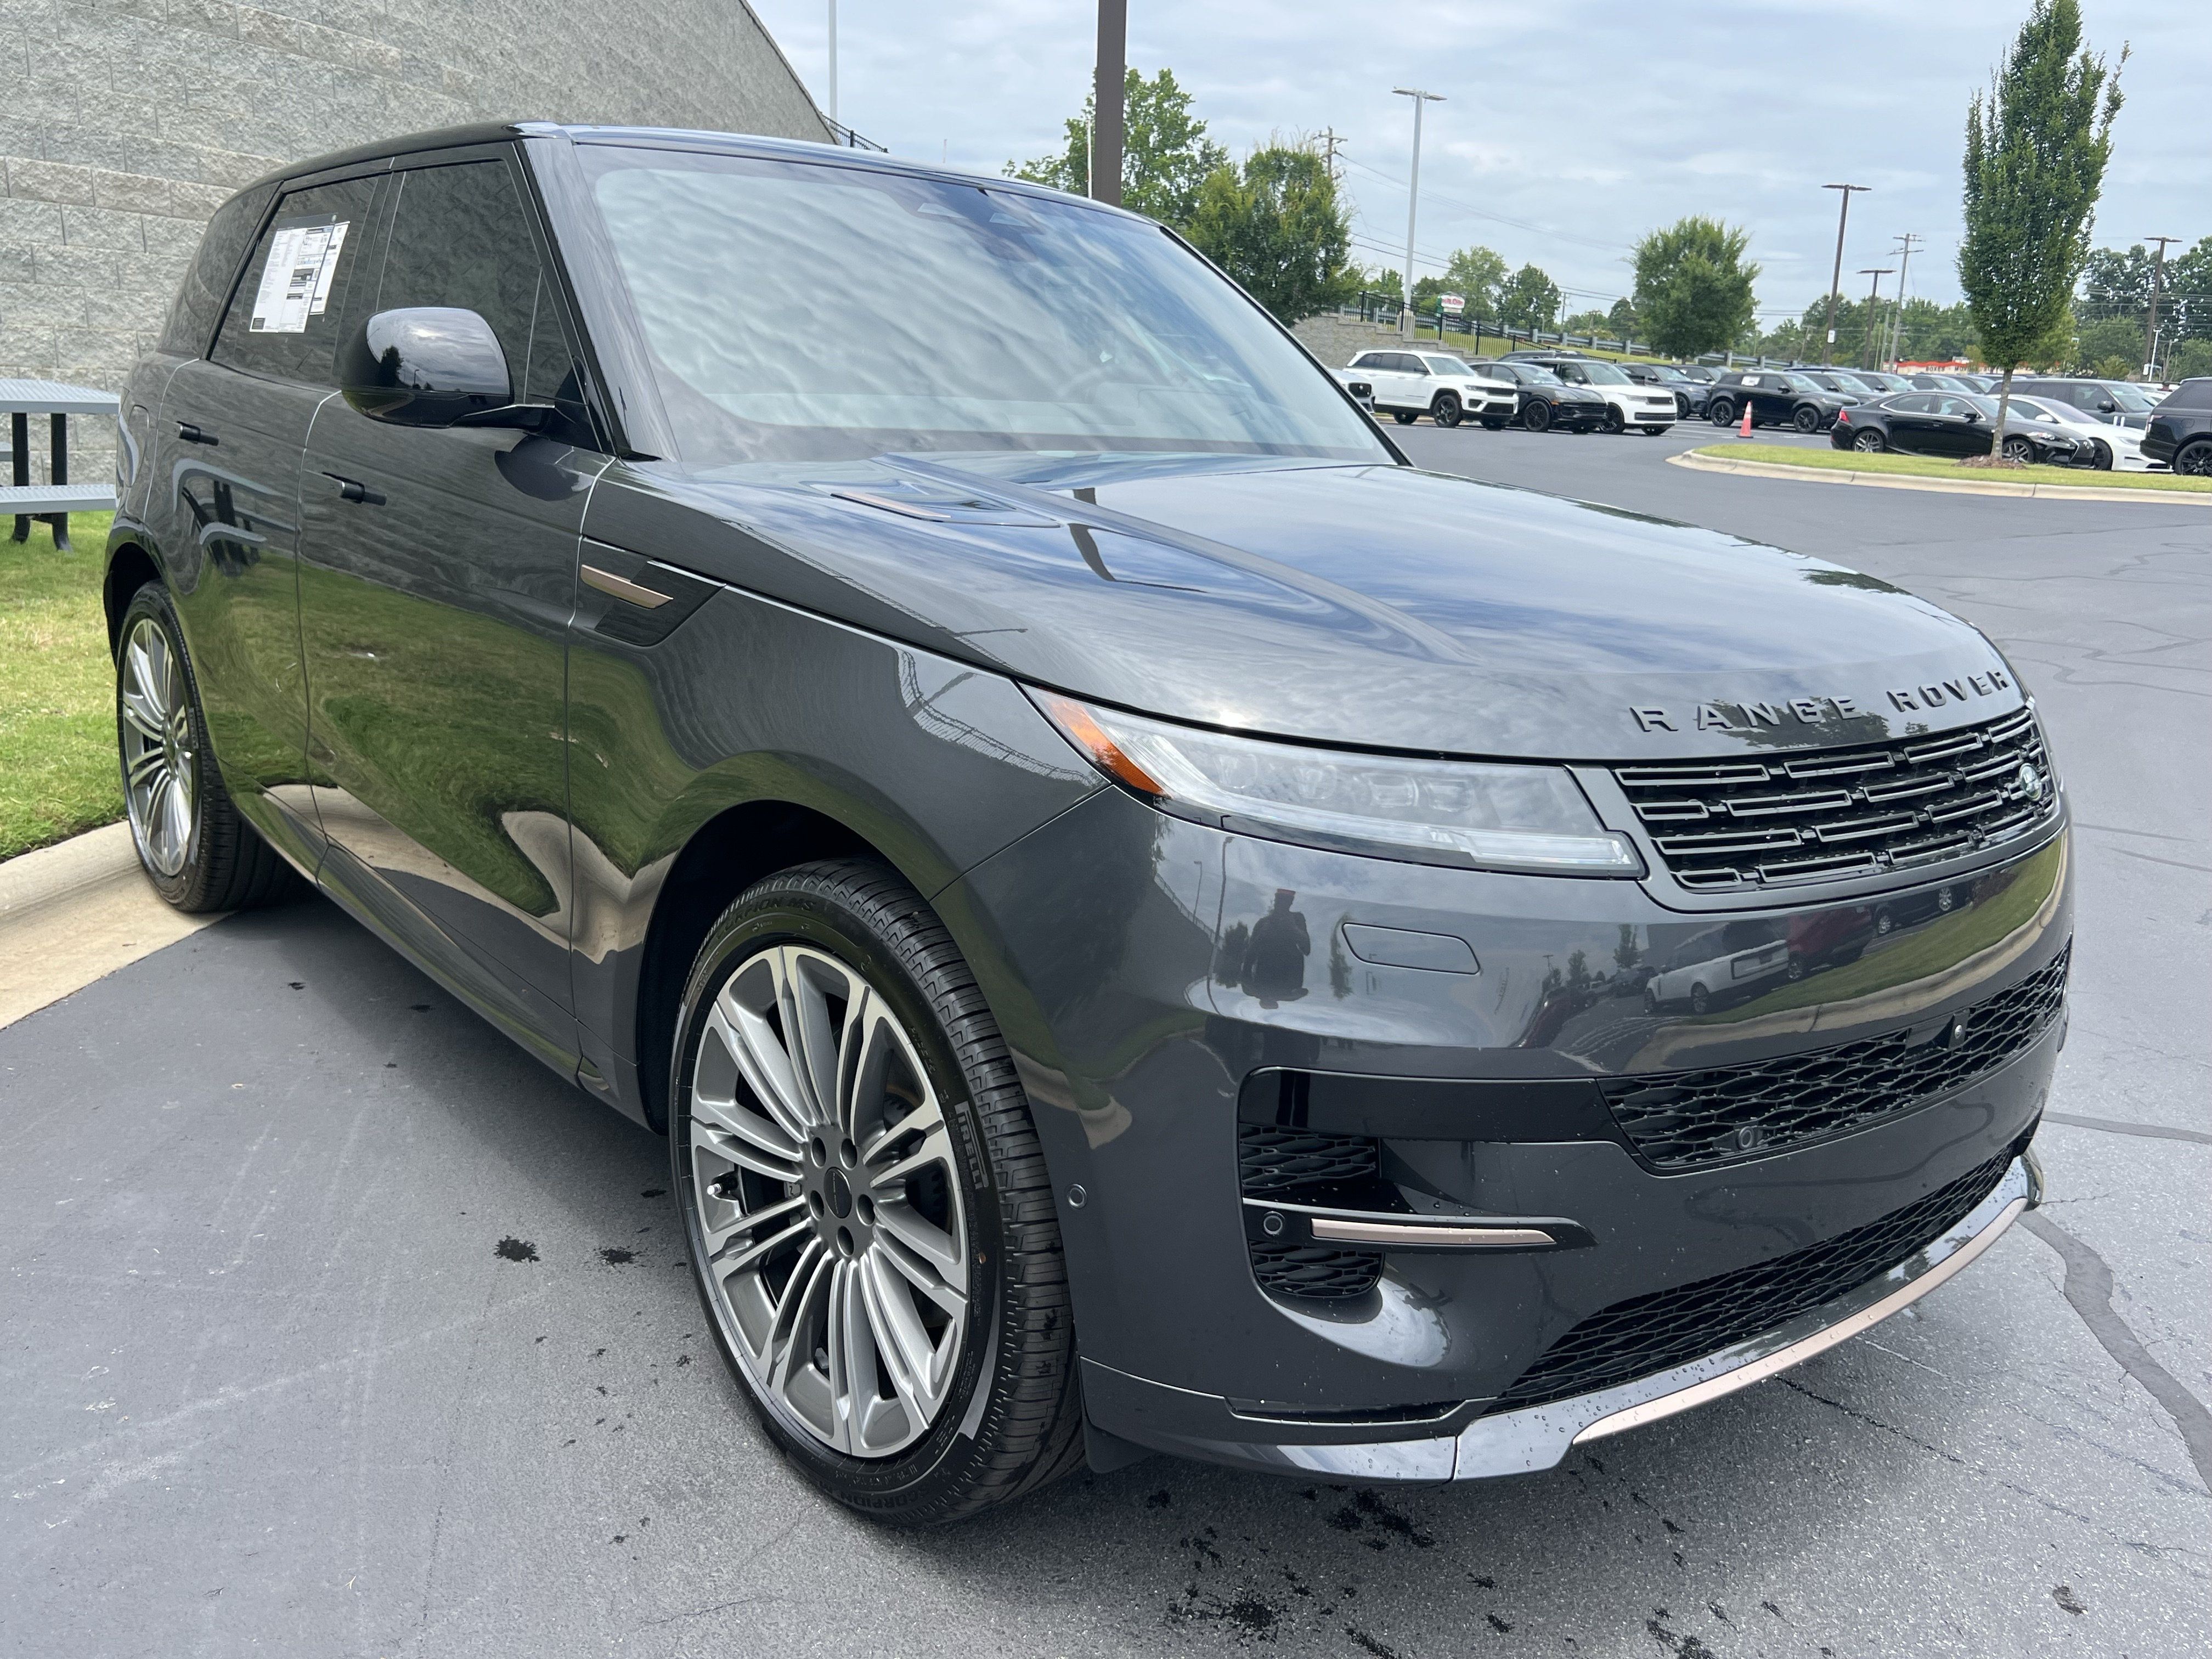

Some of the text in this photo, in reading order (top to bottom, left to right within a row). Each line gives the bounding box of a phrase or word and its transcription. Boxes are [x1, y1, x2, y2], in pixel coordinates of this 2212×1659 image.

[1629, 669, 2009, 732] RANGE ROVER
[955, 1101, 989, 1189] PIRELLI
